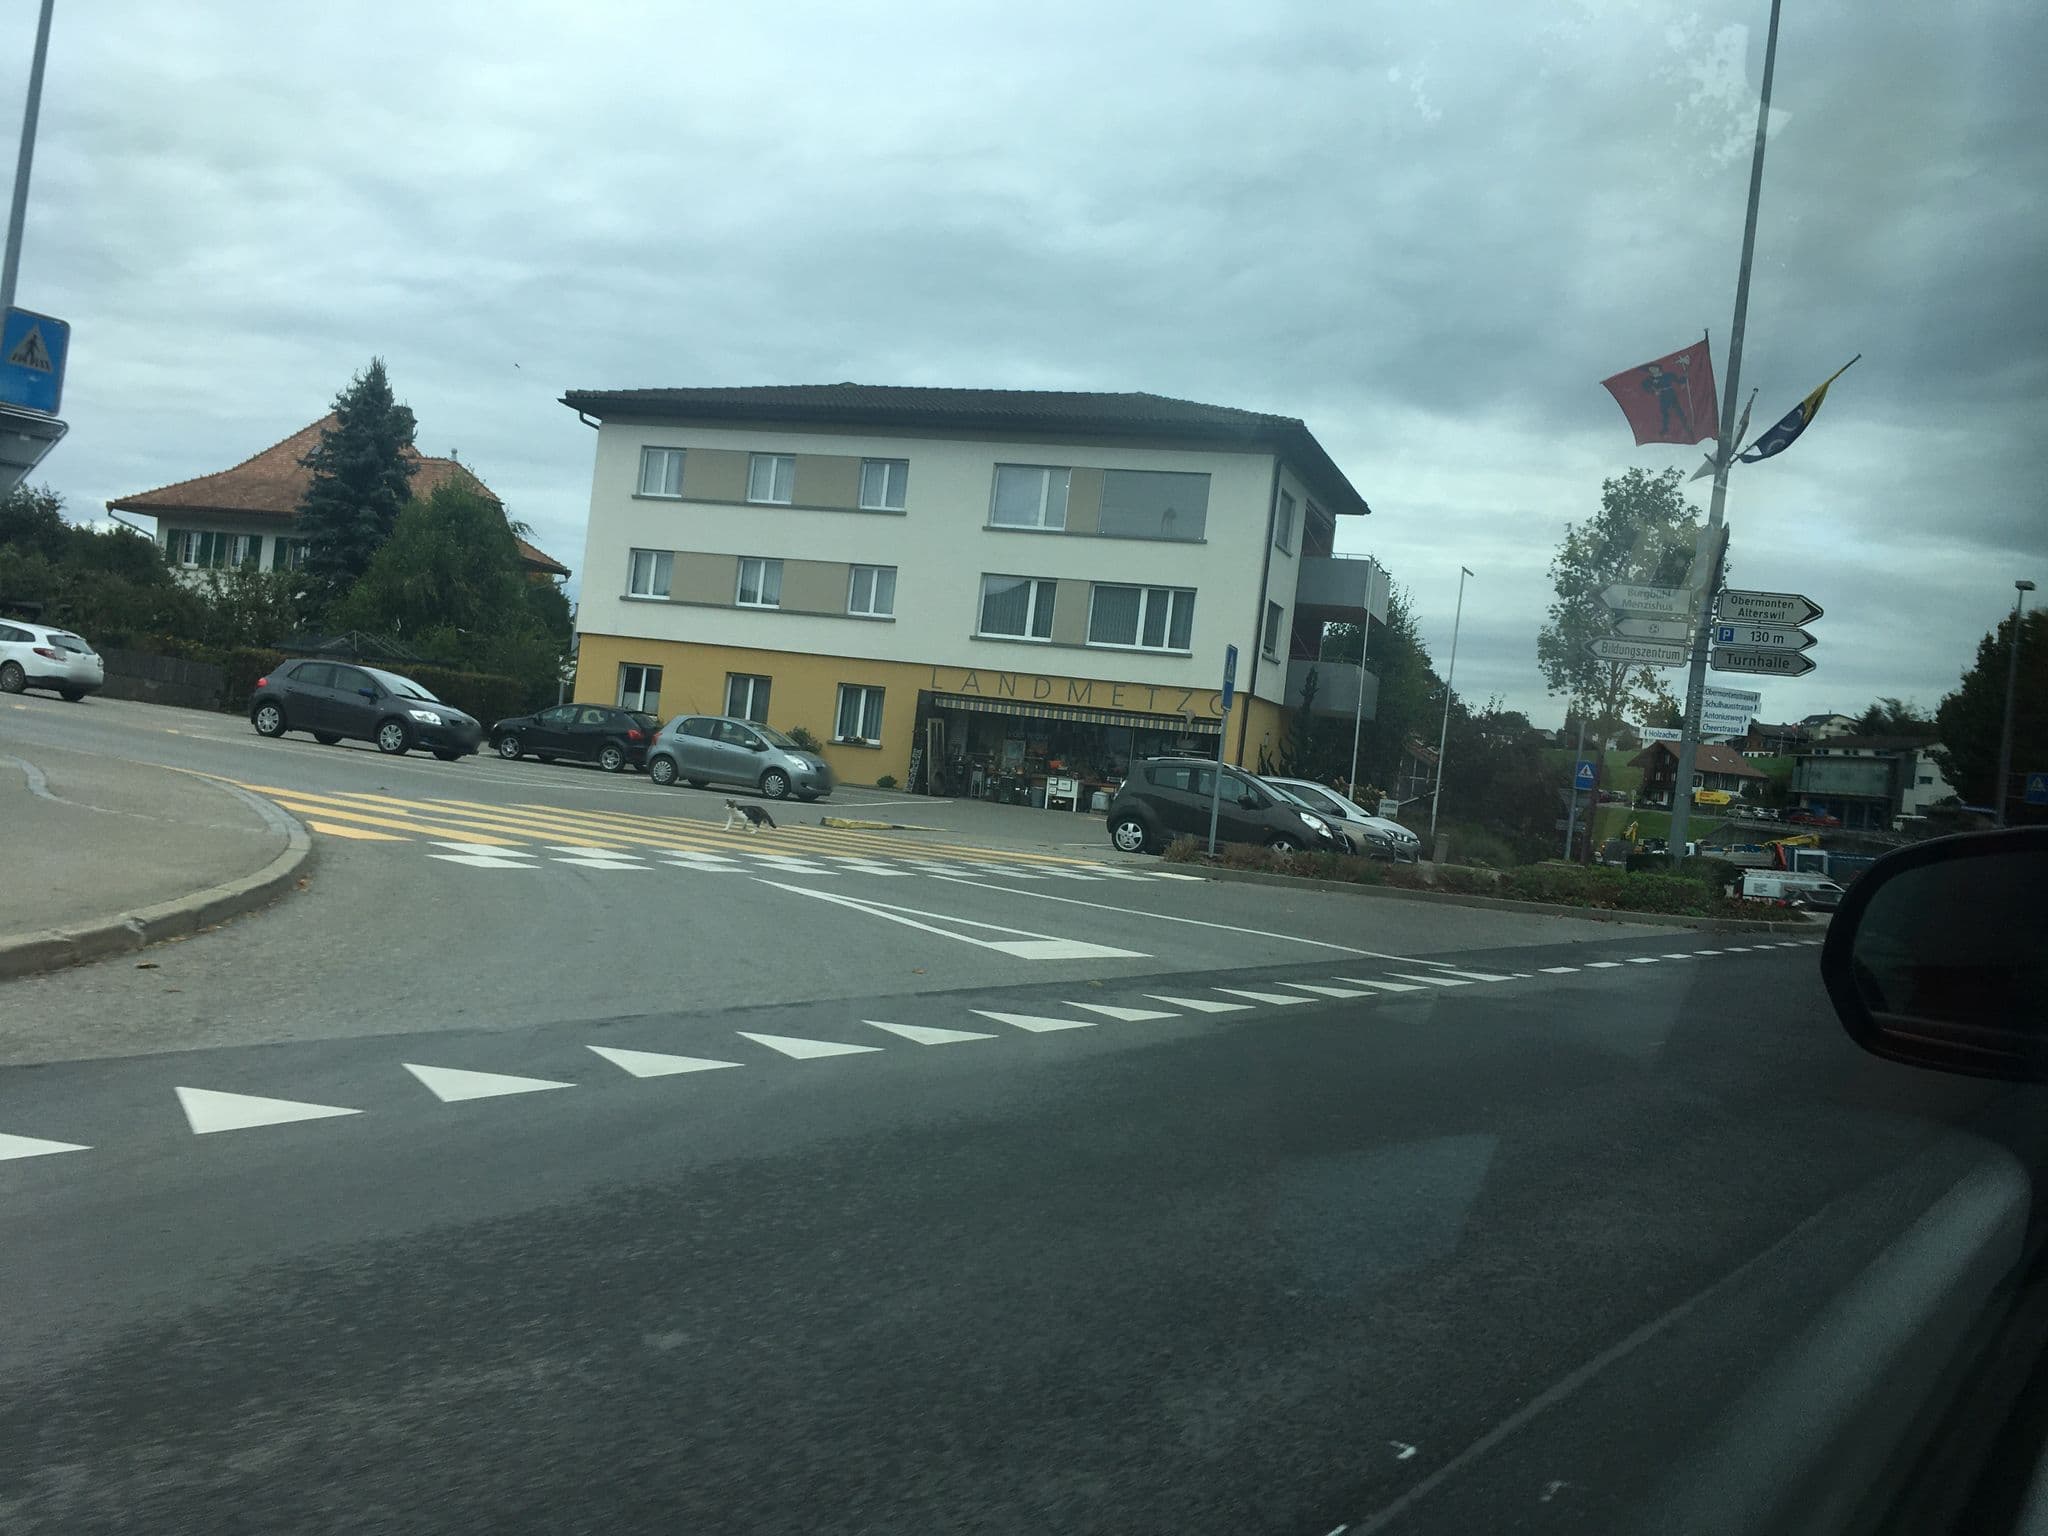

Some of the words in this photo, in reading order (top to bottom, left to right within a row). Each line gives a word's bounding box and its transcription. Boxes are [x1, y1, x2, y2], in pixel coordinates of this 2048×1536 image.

[1730, 595, 1794, 610] Obermonten
[1737, 607, 1785, 620] Alterswil
[1722, 629, 1731, 640] P
[1750, 630, 1768, 643] 130
[1772, 634, 1784, 644] m
[1601, 641, 1680, 660] Bildungszentrum
[1726, 652, 1790, 669] Turnhalle
